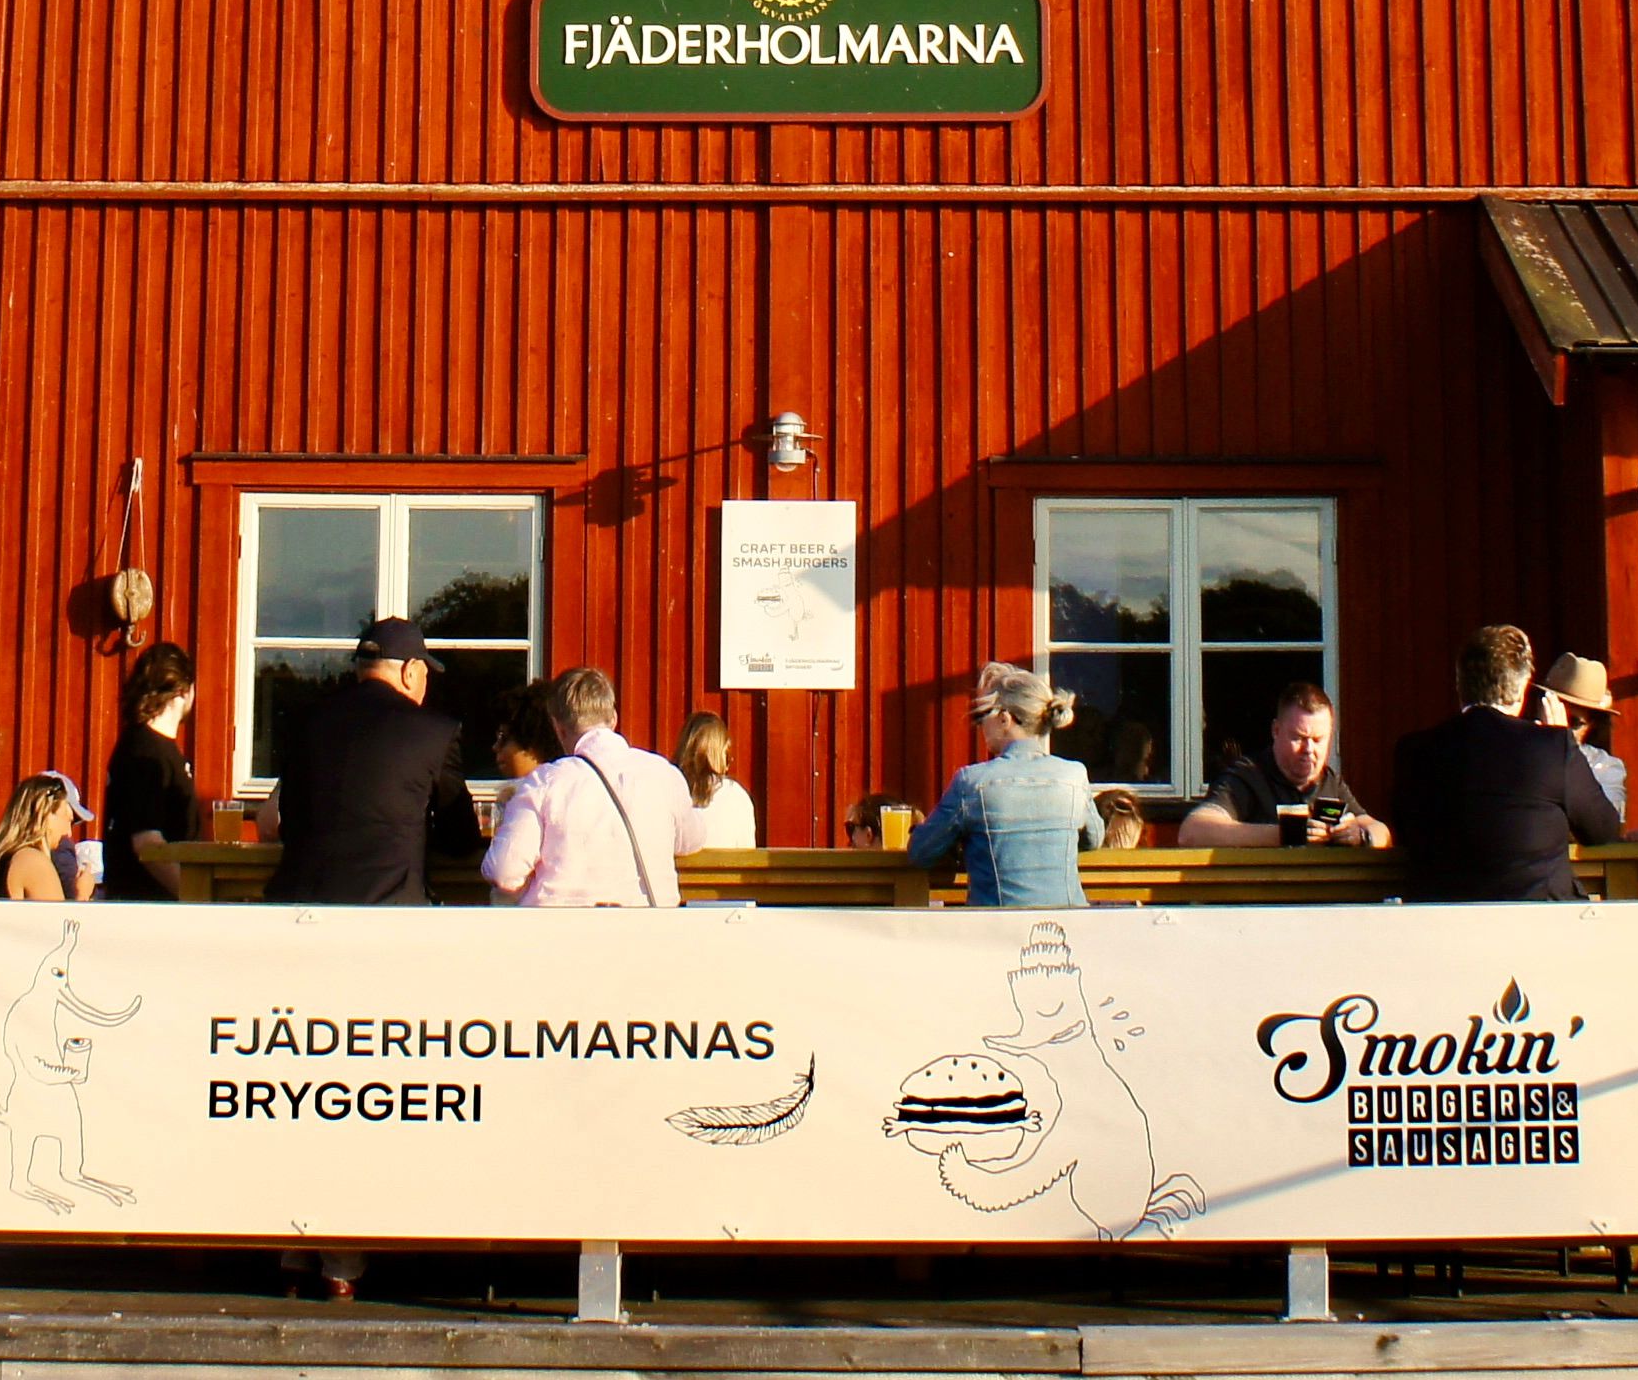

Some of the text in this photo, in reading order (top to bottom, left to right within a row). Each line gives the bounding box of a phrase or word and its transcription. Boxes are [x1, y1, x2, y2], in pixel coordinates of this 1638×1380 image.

[563, 15, 1024, 70] FJÄDERHOLMARNA
[732, 556, 848, 569] SMASH BURGERS
[740, 542, 839, 555] CRAFT BEER &
[208, 1007, 776, 1061] FJÄDERHOLMARNAS
[1256, 994, 1585, 1104] Smokin'
[207, 1080, 483, 1123] BRYGGERI
[1352, 1130, 1576, 1163] SAUSAGES
